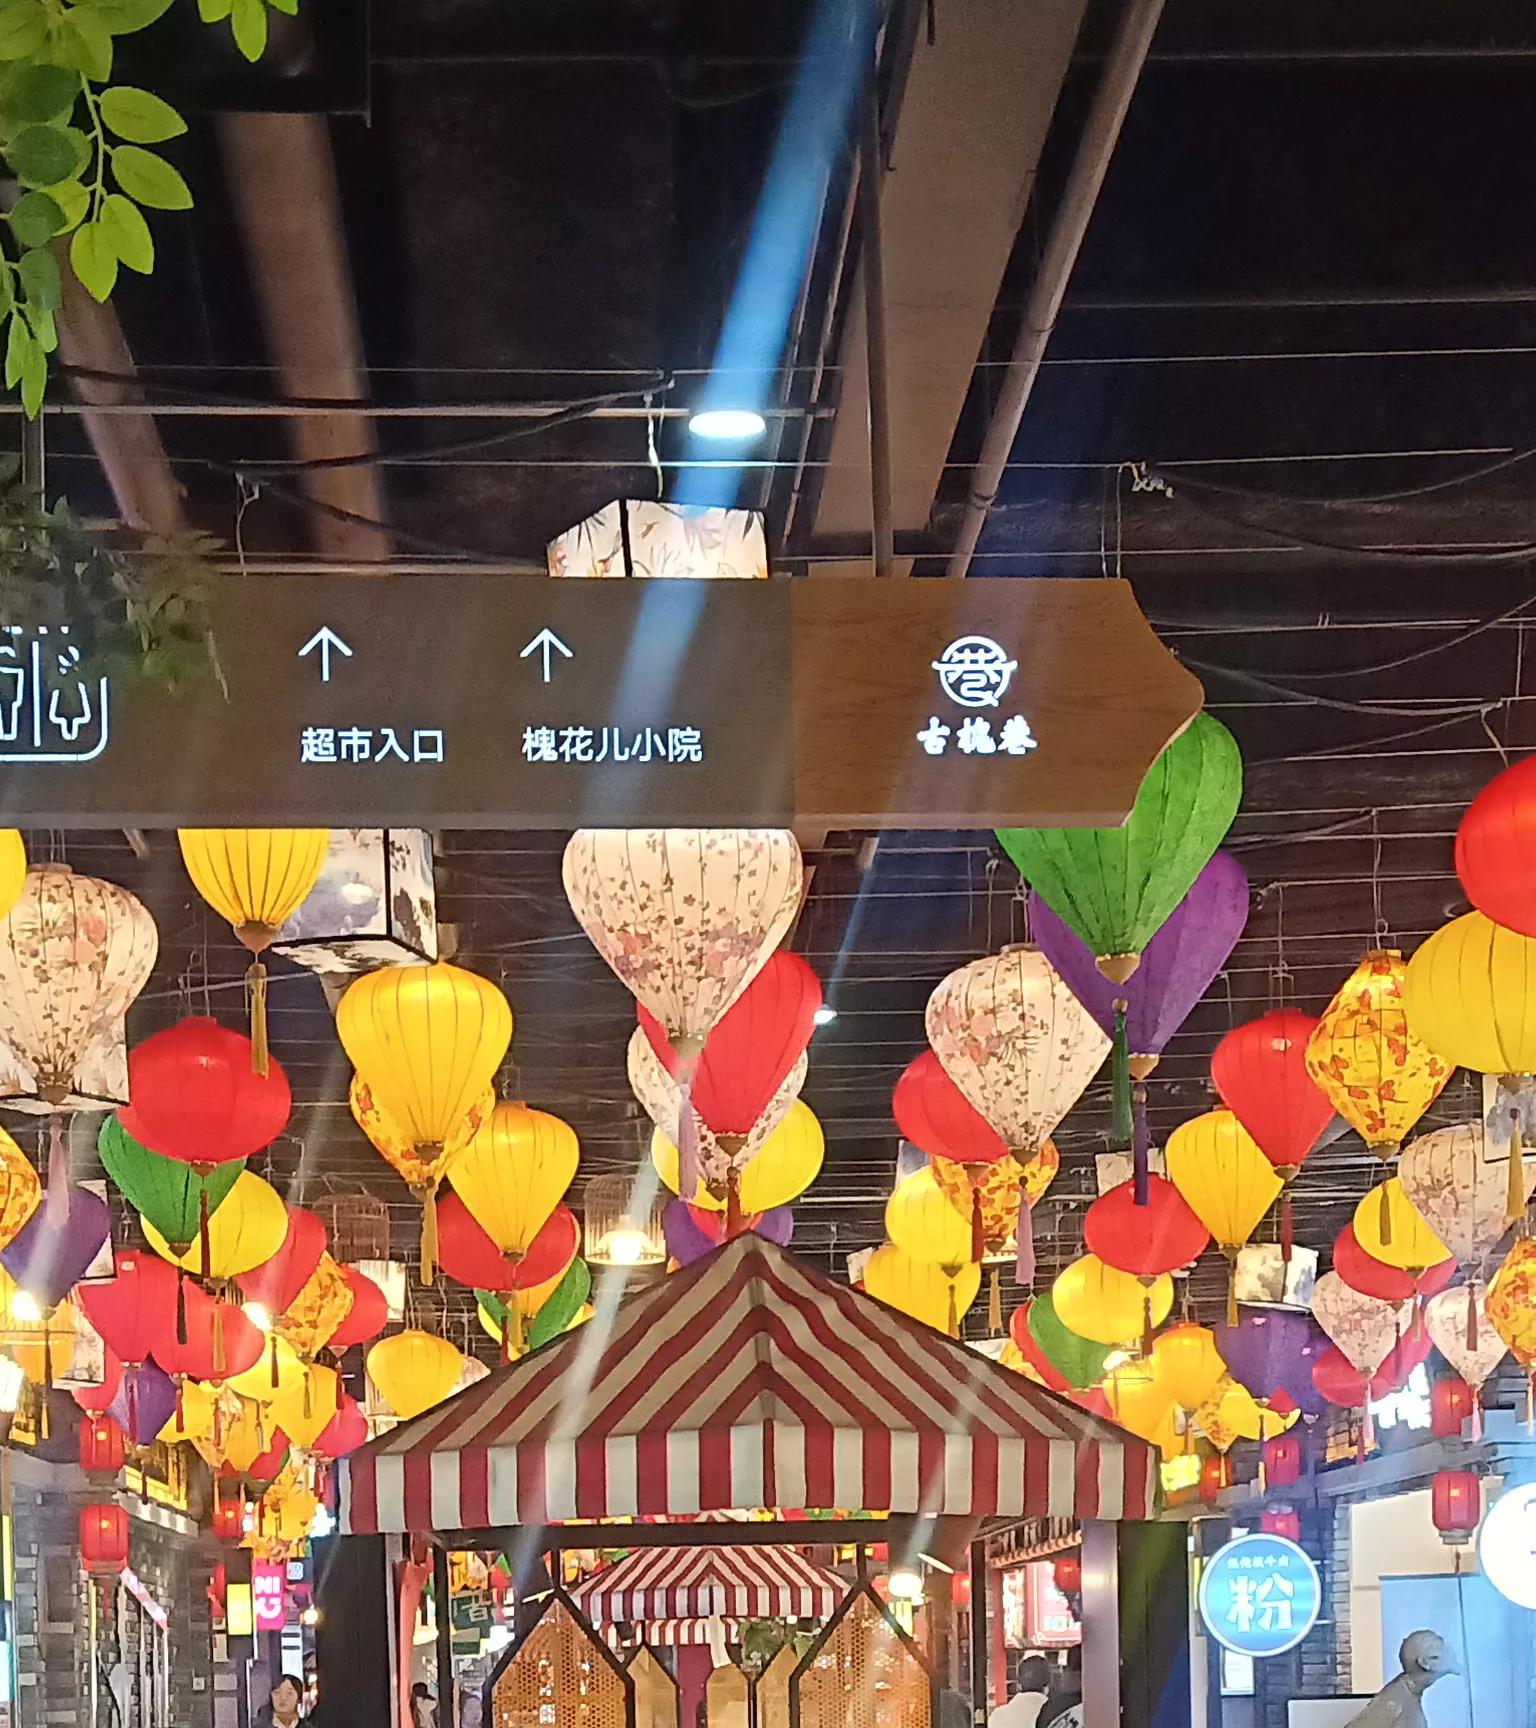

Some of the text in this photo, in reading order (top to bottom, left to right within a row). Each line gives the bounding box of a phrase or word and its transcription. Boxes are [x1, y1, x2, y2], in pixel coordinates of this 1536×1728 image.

[300, 726, 445, 763] 超市入口
[522, 726, 703, 763] 槐花儿小院
[916, 714, 1038, 755] 古槐巷
[1225, 1572, 1294, 1633] 粉
